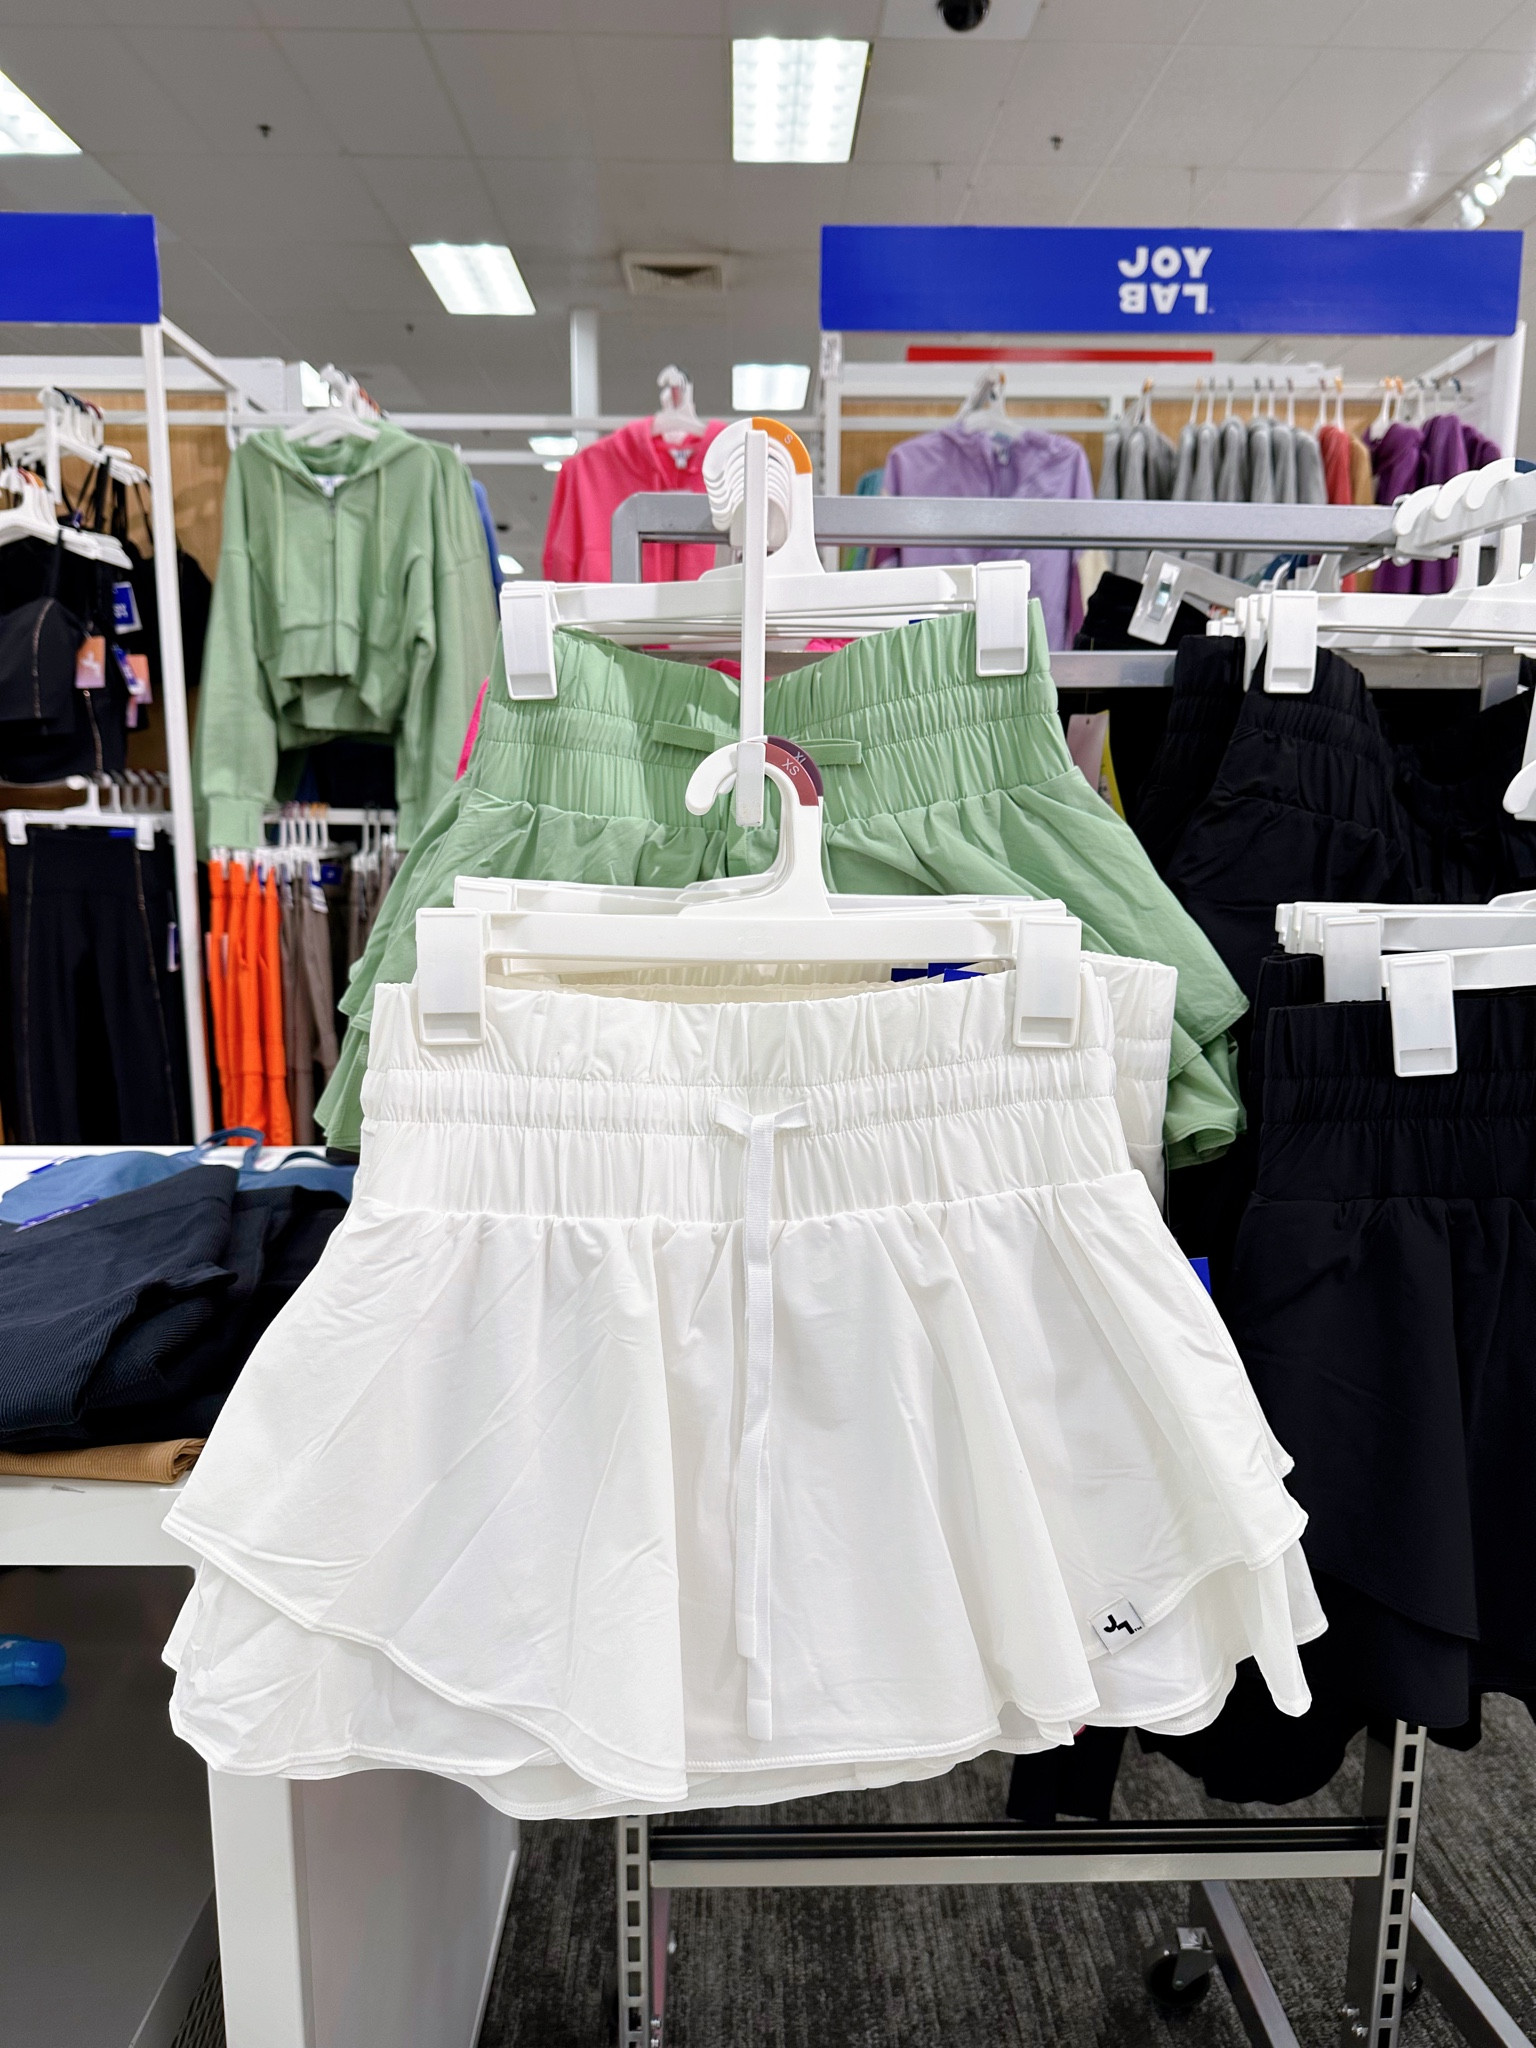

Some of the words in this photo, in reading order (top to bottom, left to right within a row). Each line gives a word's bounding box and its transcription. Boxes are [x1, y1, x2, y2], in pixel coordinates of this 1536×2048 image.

[1117, 245, 1213, 279] JOY
[1118, 282, 1209, 315] LAB
[784, 434, 793, 444] S
[781, 758, 800, 776] XS
